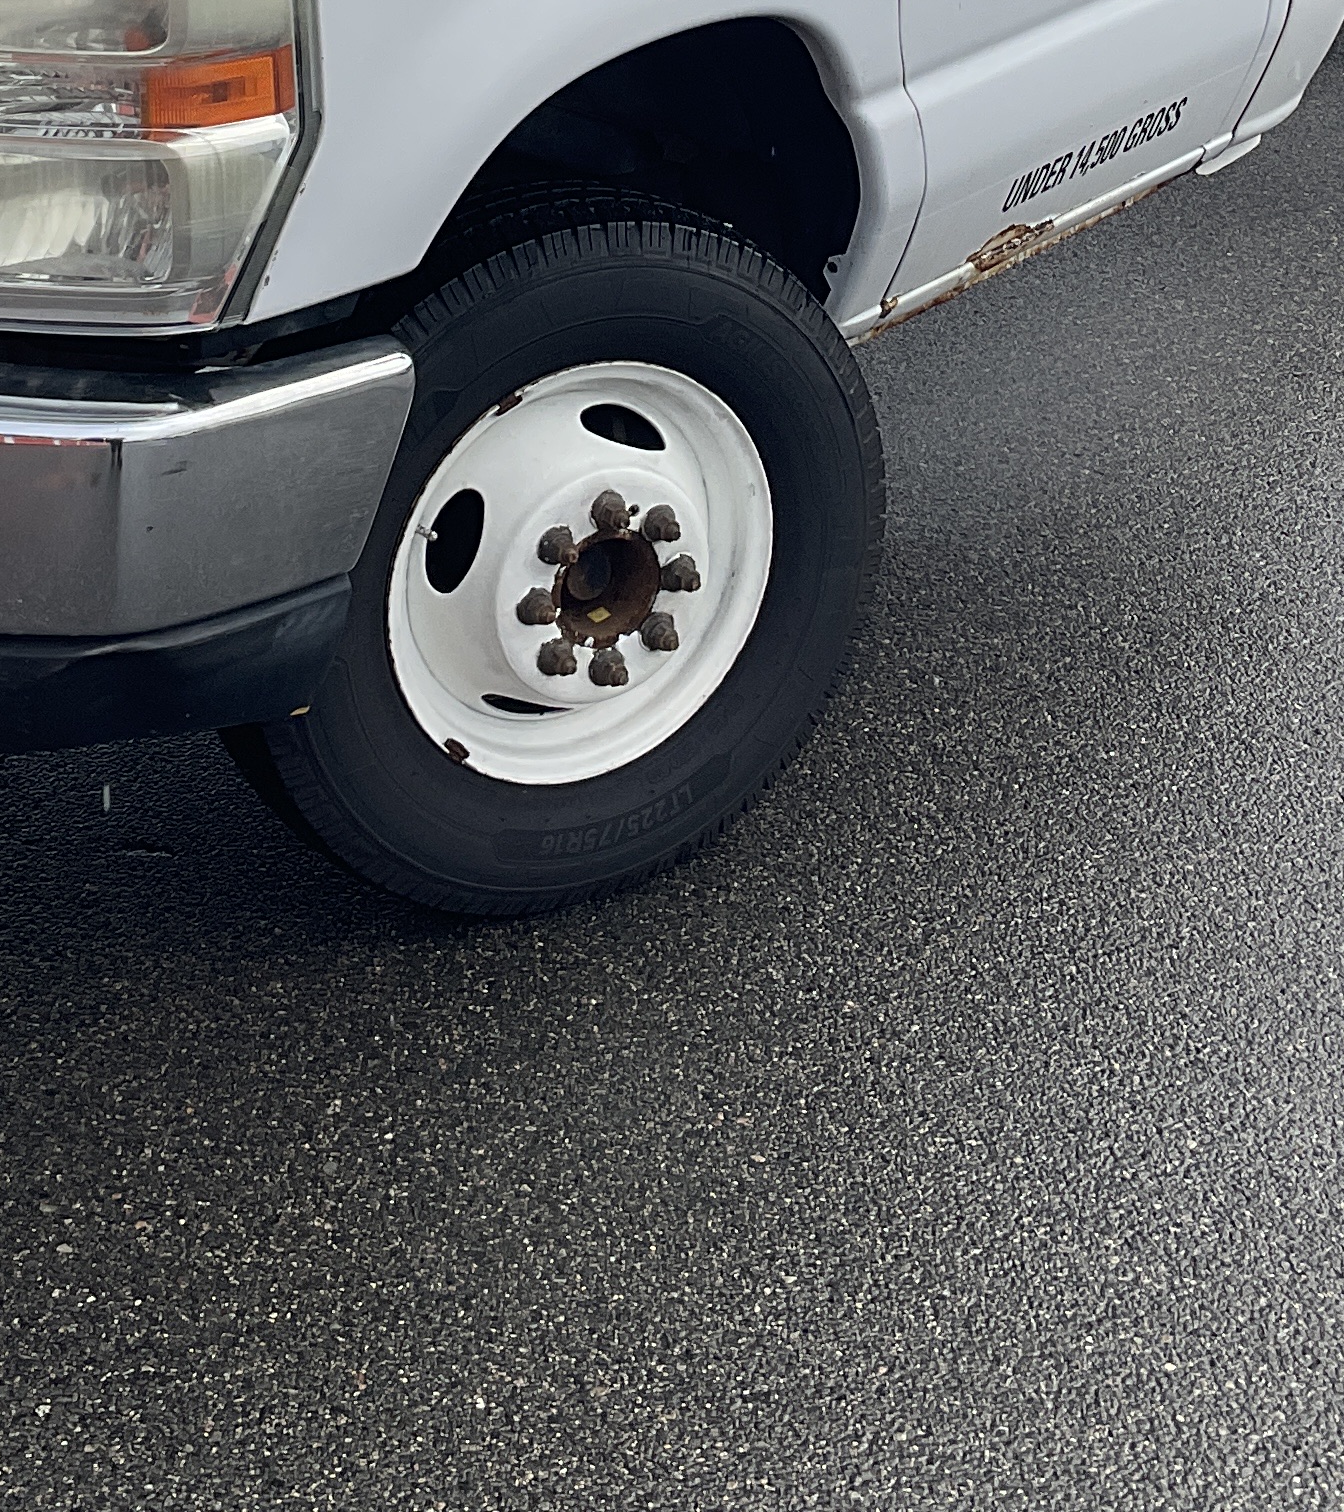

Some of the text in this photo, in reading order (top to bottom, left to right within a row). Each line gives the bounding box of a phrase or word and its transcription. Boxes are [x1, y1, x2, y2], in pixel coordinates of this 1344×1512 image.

[1001, 96, 1188, 213] UNDER 14,500 GROSS
